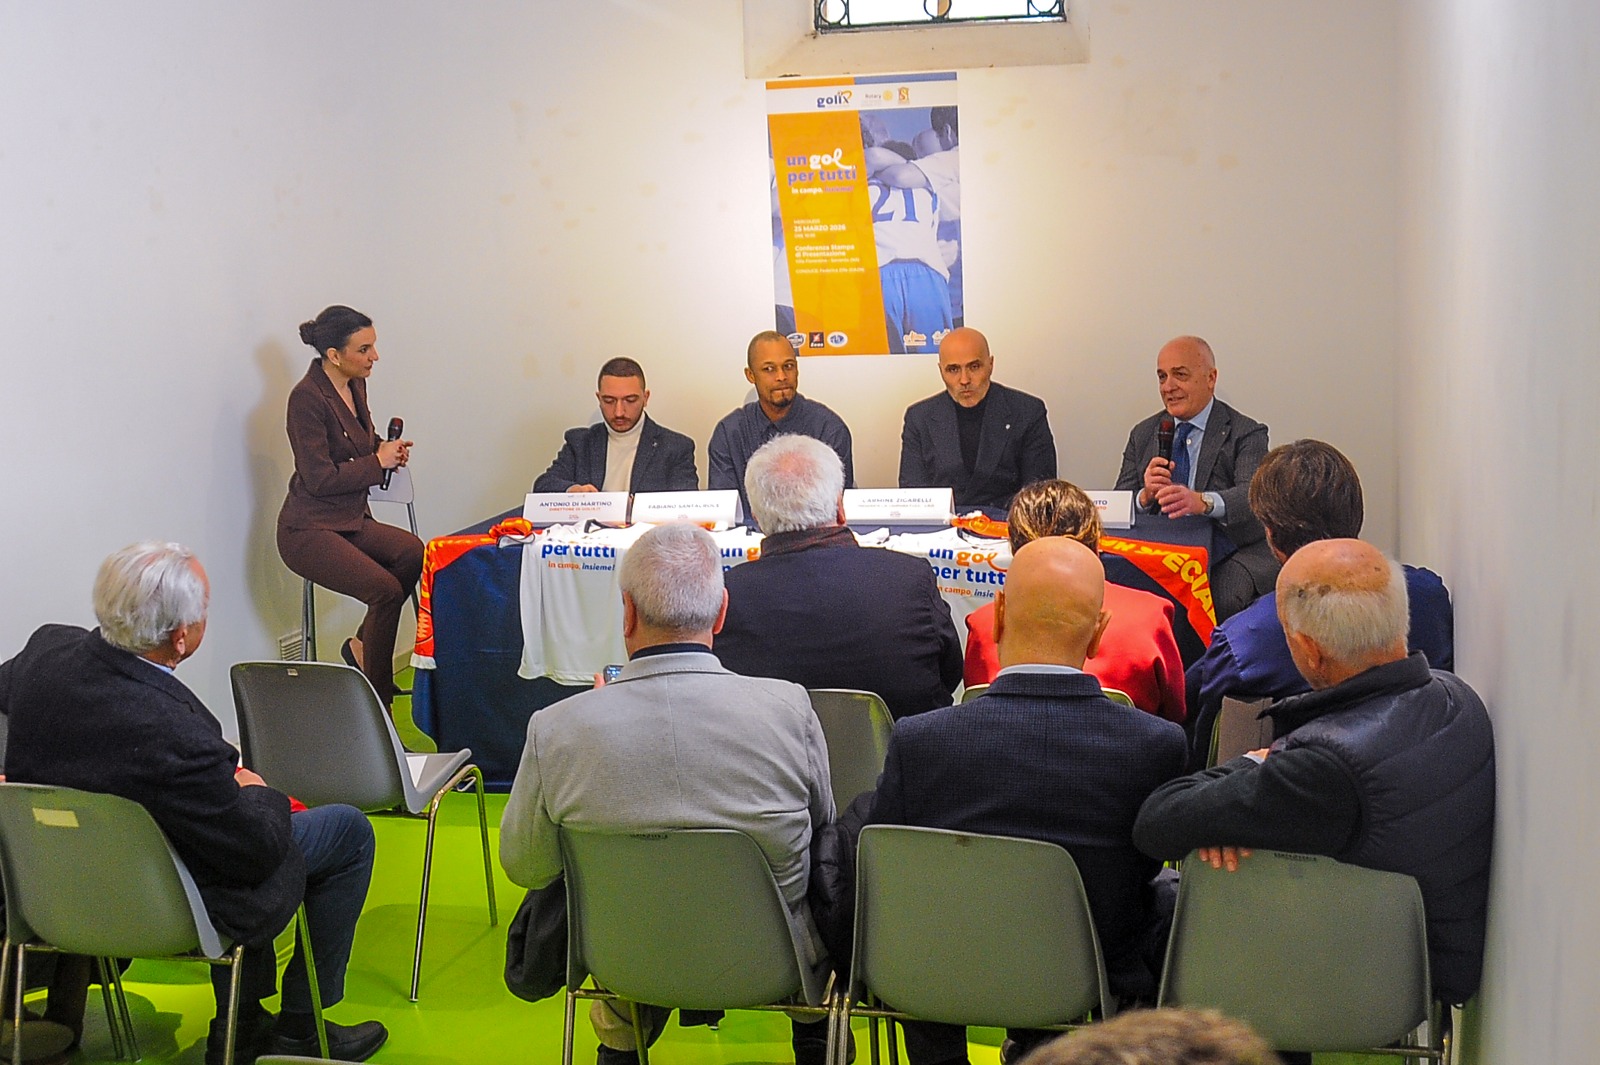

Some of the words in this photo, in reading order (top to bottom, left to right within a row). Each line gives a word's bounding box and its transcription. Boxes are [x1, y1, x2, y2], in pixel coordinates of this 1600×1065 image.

[787, 156, 806, 166] un
[809, 148, 856, 170] gol
[787, 171, 814, 186] per
[819, 169, 856, 181] tutti
[803, 224, 829, 232] MARZO
[541, 544, 570, 558] per
[573, 546, 616, 558] tutti
[721, 548, 743, 558] un
[929, 548, 954, 560] un
[582, 562, 615, 571] insieme!
[966, 568, 1007, 585] tutt
